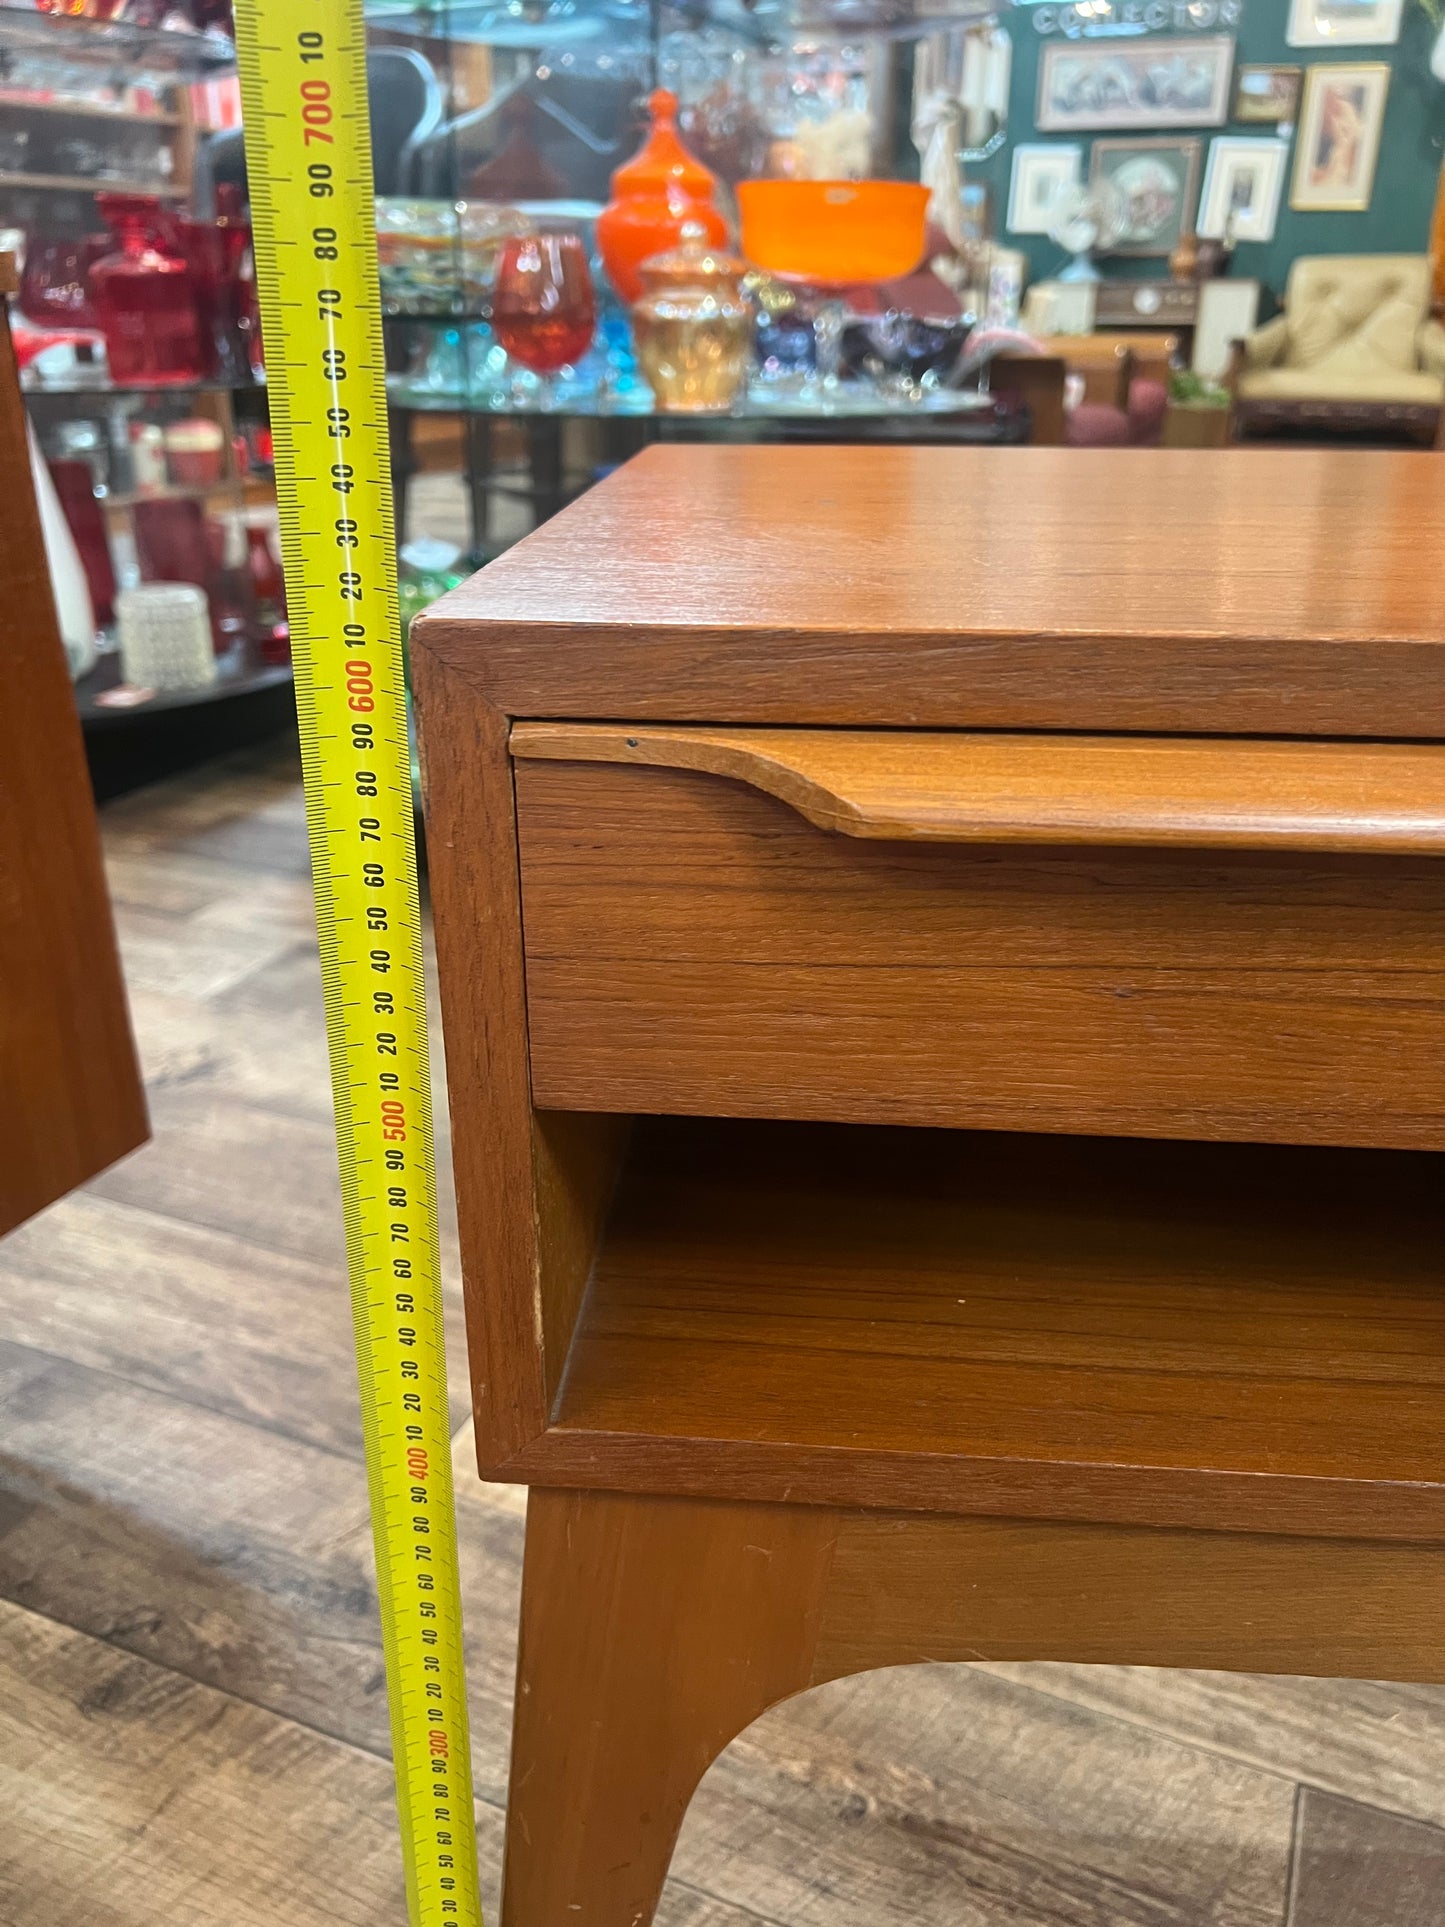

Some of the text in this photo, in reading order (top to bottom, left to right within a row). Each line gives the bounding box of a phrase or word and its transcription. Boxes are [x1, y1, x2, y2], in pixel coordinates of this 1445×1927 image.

[298, 32, 324, 64] 10
[300, 80, 333, 146] 700
[307, 164, 334, 198] 90
[312, 227, 338, 261] 80
[317, 289, 343, 321] 70
[322, 349, 347, 381] 60
[326, 407, 351, 438] 50
[330, 464, 355, 494] 40
[334, 519, 359, 548] 30
[338, 572, 363, 601] 20
[343, 624, 366, 648] 10
[345, 660, 375, 713] 600
[351, 723, 374, 750] 90
[355, 771, 378, 797] 80
[358, 818, 381, 842] 70
[362, 863, 385, 888] 60
[366, 907, 388, 931] 50
[369, 950, 391, 974] 40
[373, 991, 395, 1015] 30
[376, 1032, 397, 1056] 20
[379, 1072, 400, 1092] 10
[381, 1101, 407, 1142] 500
[384, 1149, 405, 1171] 90
[387, 1187, 408, 1208] 80
[390, 1223, 410, 1243] 70
[392, 1258, 412, 1279] 60
[395, 1293, 415, 1313] 50
[398, 1327, 417, 1347] 40
[400, 1360, 419, 1380] 30
[402, 1393, 421, 1413] 20
[405, 1425, 424, 1441] 10
[406, 1447, 429, 1481] 400
[410, 1486, 428, 1504] 90
[412, 1516, 430, 1534] 80
[415, 1545, 432, 1562] 70
[417, 1573, 435, 1591] 60
[419, 1602, 437, 1618] 50
[421, 1629, 438, 1646] 40
[423, 1656, 440, 1673] 30
[425, 1682, 442, 1699] 20
[427, 1708, 444, 1722] 10
[428, 1730, 449, 1758] 300
[431, 1759, 447, 1774] 90
[432, 1783, 449, 1799] 80
[434, 1807, 451, 1822] 70
[436, 1831, 453, 1846] 60
[438, 1854, 454, 1869] 50
[440, 1877, 455, 1891] 40
[441, 1899, 458, 1913] 30
